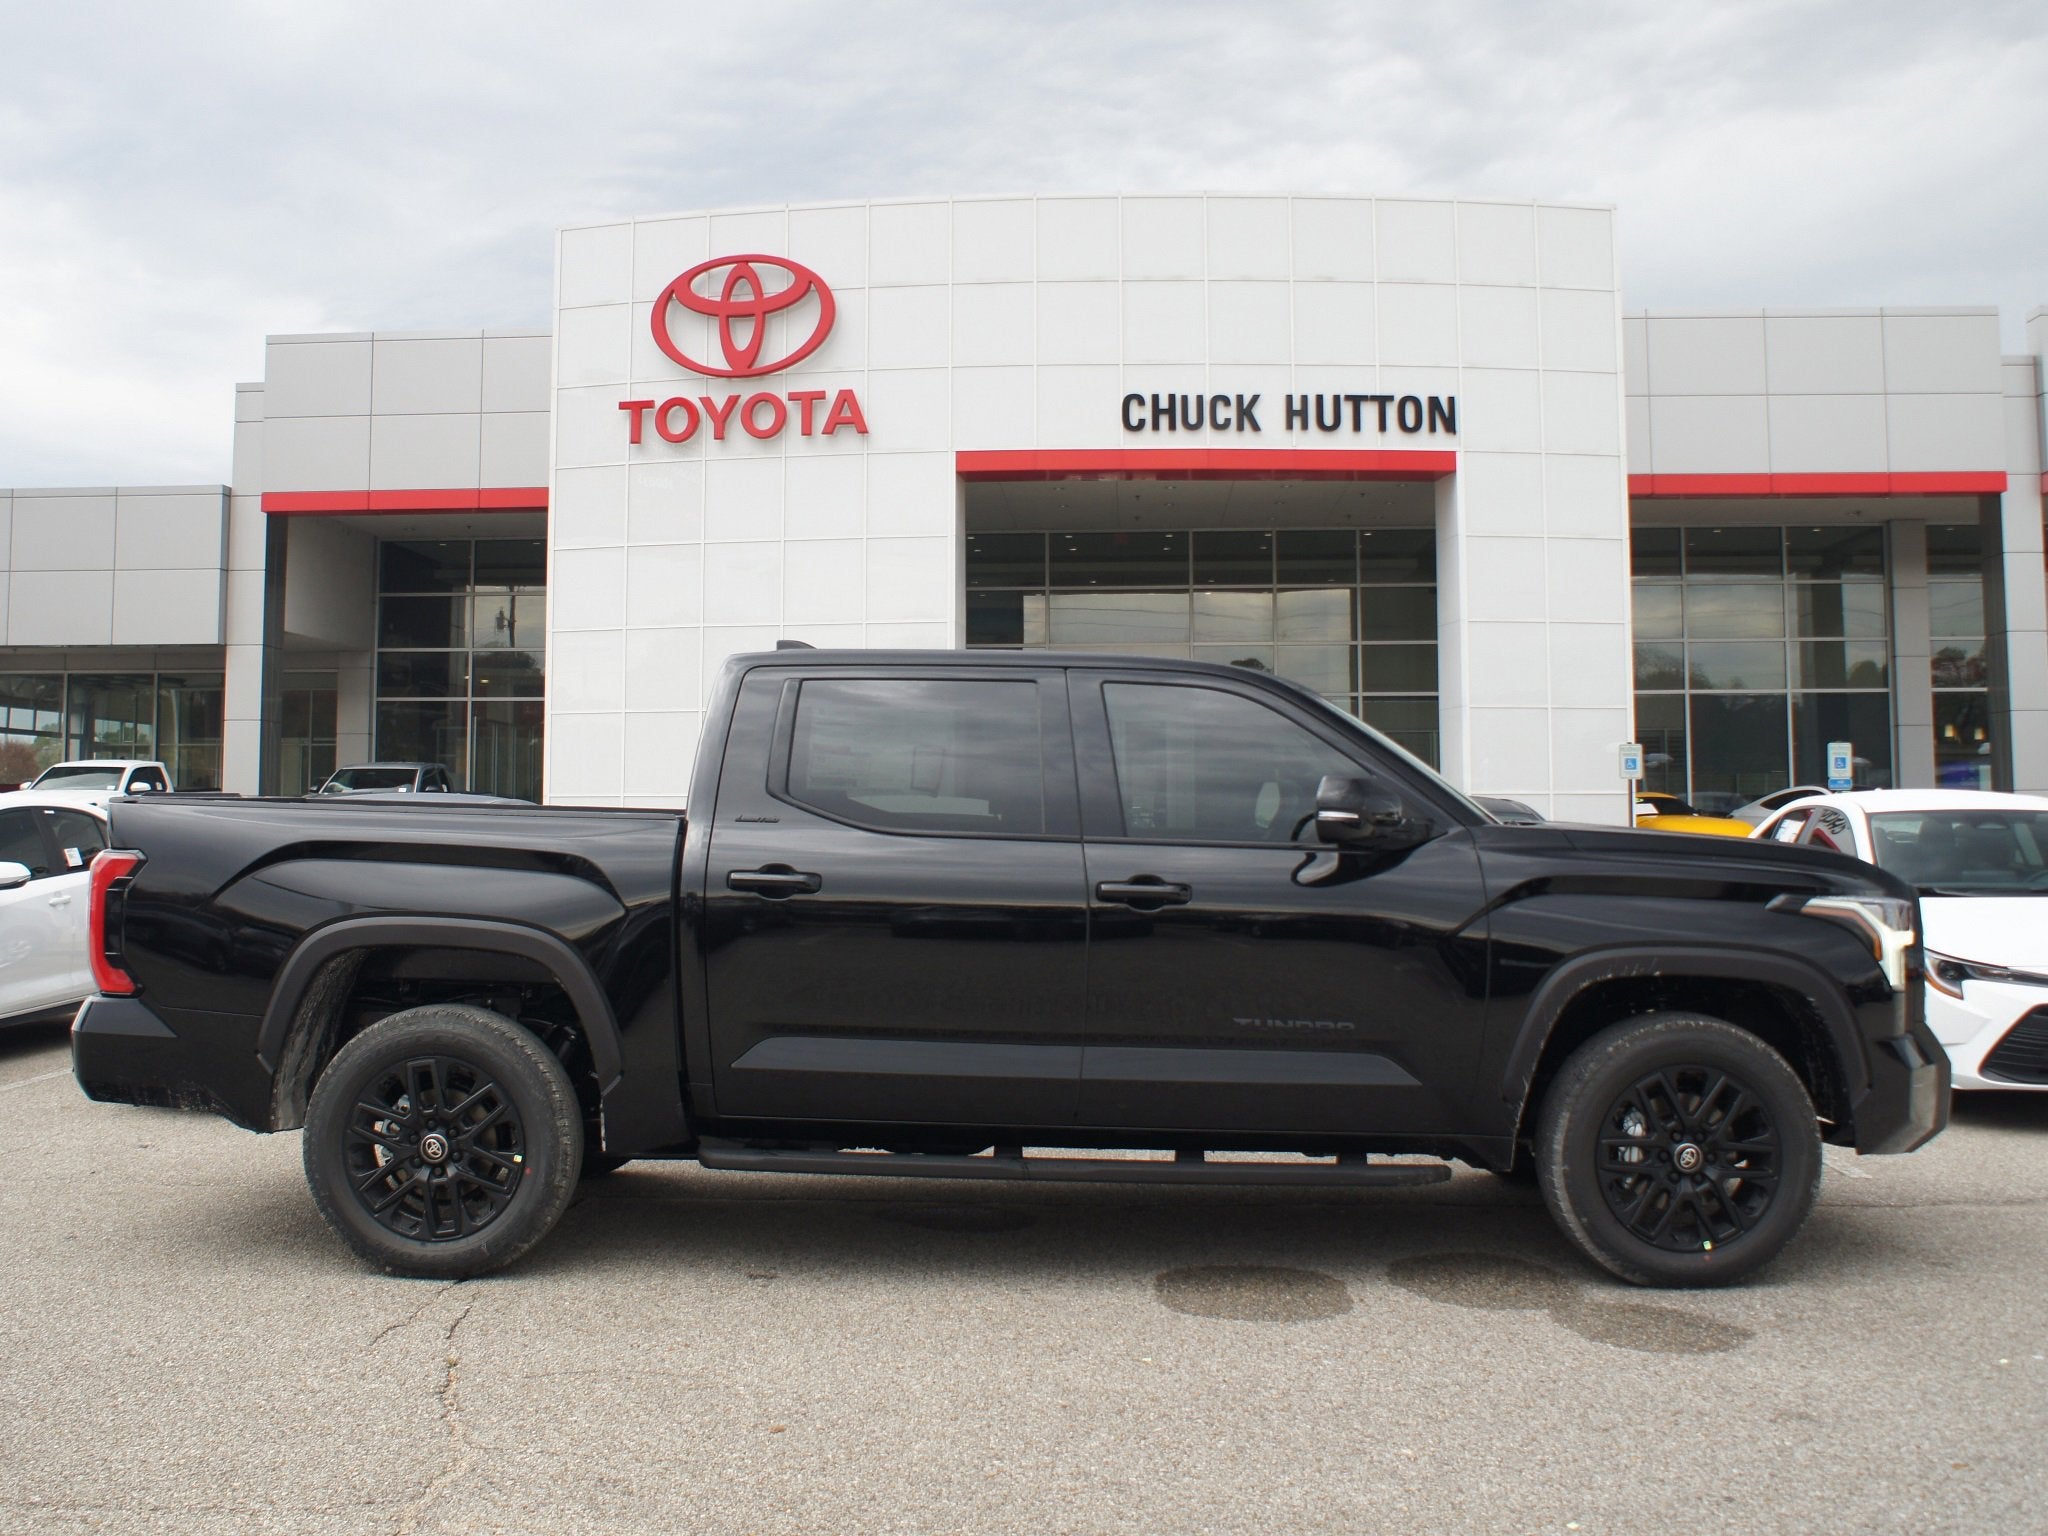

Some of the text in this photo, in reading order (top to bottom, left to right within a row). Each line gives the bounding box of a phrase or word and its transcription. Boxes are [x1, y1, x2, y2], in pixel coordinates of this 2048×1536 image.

[618, 389, 870, 445] TOYOTA
[1121, 393, 1457, 435] CHUCK HUTTON
